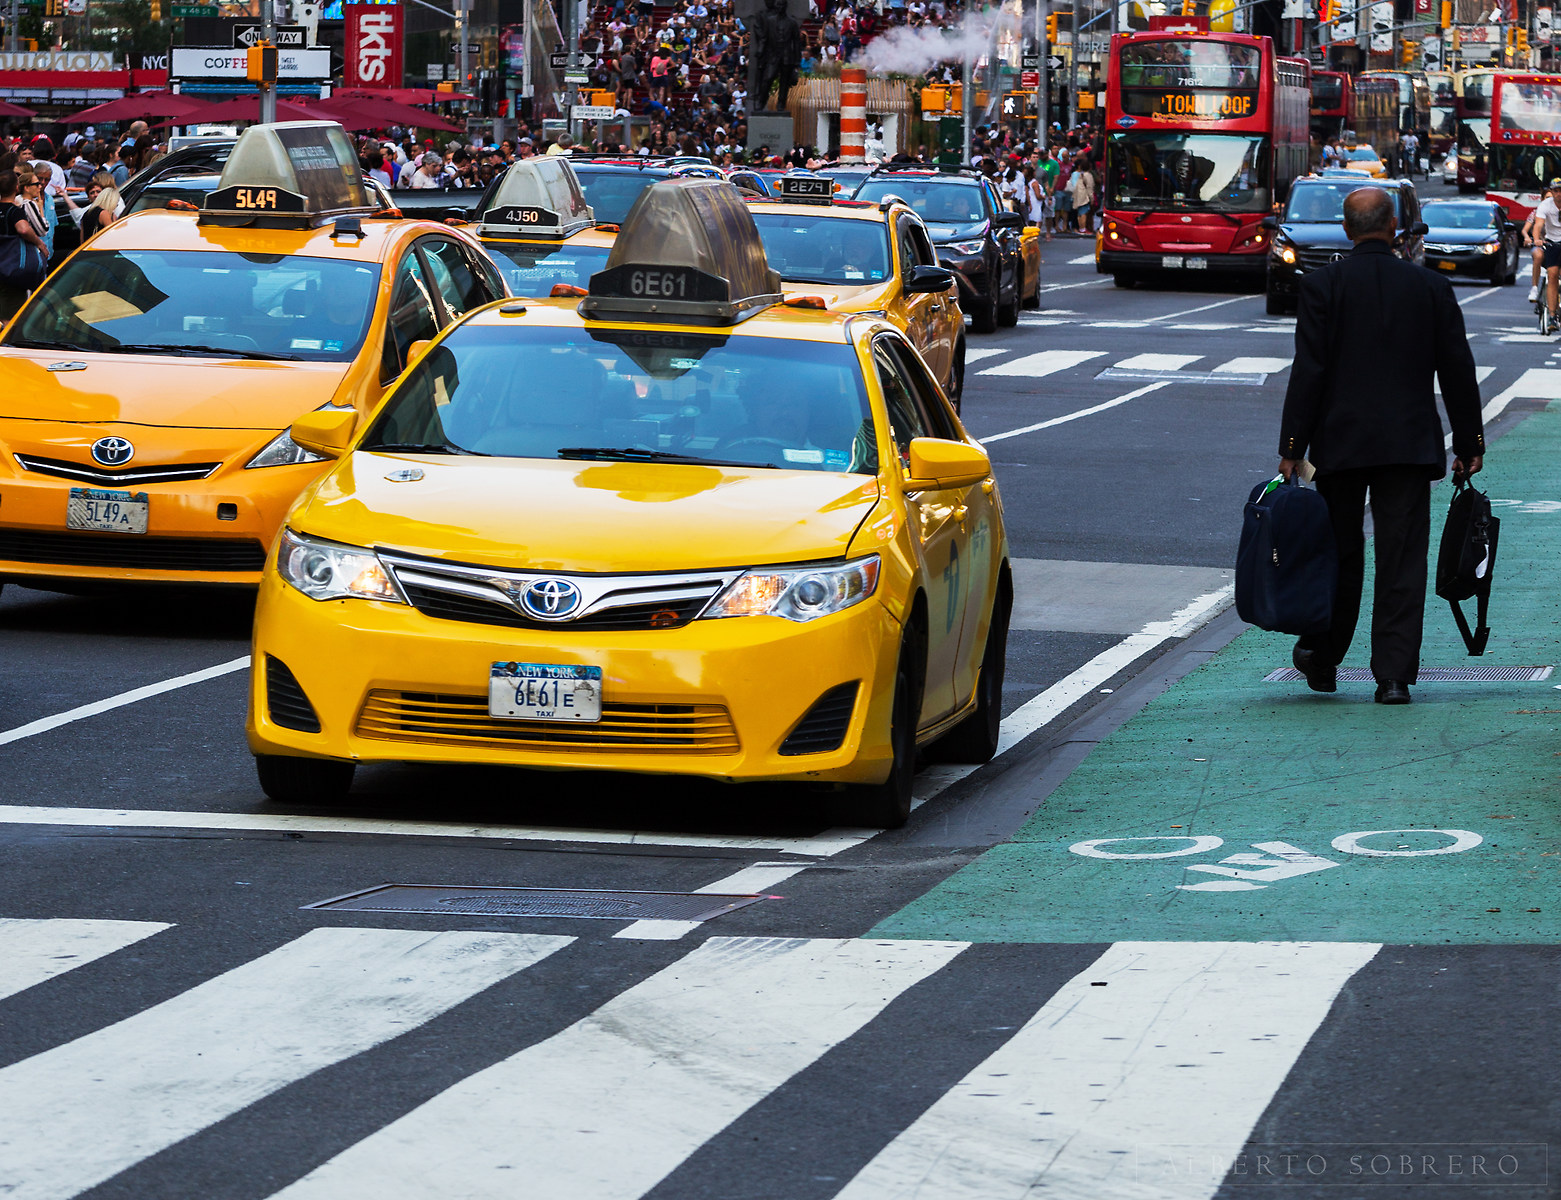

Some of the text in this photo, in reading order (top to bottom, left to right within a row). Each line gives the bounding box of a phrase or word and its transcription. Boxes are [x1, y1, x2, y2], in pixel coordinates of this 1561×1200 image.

[245, 32, 298, 43] ON WAY
[358, 11, 395, 82] tkts
[204, 57, 248, 69] COFFE
[1177, 77, 1204, 87] 71612
[790, 180, 824, 193] 2E79
[236, 189, 277, 209] 5L49
[505, 210, 539, 223] 4J50
[631, 271, 687, 297] 6E61
[518, 665, 576, 679] NEW YORK
